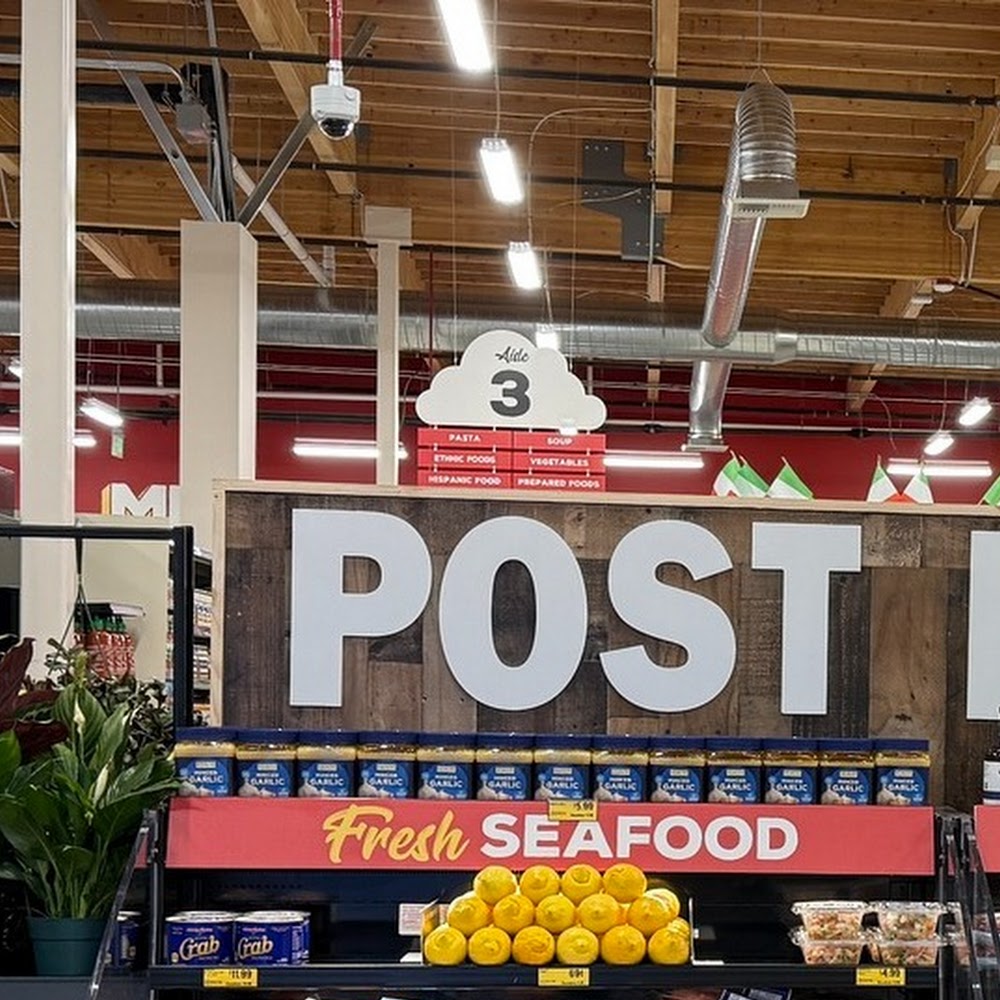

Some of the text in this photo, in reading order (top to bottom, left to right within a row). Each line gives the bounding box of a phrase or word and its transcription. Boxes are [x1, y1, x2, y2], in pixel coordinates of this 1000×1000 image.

[495, 346, 530, 363] Aisle
[490, 369, 531, 417] 3
[448, 433, 482, 442] PASTA
[547, 437, 573, 445] SOUP
[434, 454, 496, 464] ETHNIC FOODS
[530, 457, 589, 467] VEGETABLES
[428, 476, 473, 485] HISPANIC
[517, 478, 600, 489] PREPARED FOODS
[290, 508, 862, 716] POST
[189, 774, 223, 784] GARLIC
[250, 777, 284, 787] GARLIC
[309, 777, 344, 787] GARLIC
[369, 777, 403, 787] GARLIC
[429, 778, 464, 788] GARLIC
[488, 780, 521, 789] GARLIC
[546, 781, 579, 790] GARLIC
[604, 782, 637, 791] GARLIC
[663, 782, 696, 791] GARLIC
[718, 782, 752, 792] GARLIC
[775, 783, 808, 792] GARLIC
[832, 783, 864, 793] GARLIC
[888, 783, 920, 792] GARLIC
[322, 803, 799, 864] Fresh SEAFOOD
[179, 935, 220, 961] Crab
[238, 935, 274, 959] Crab
